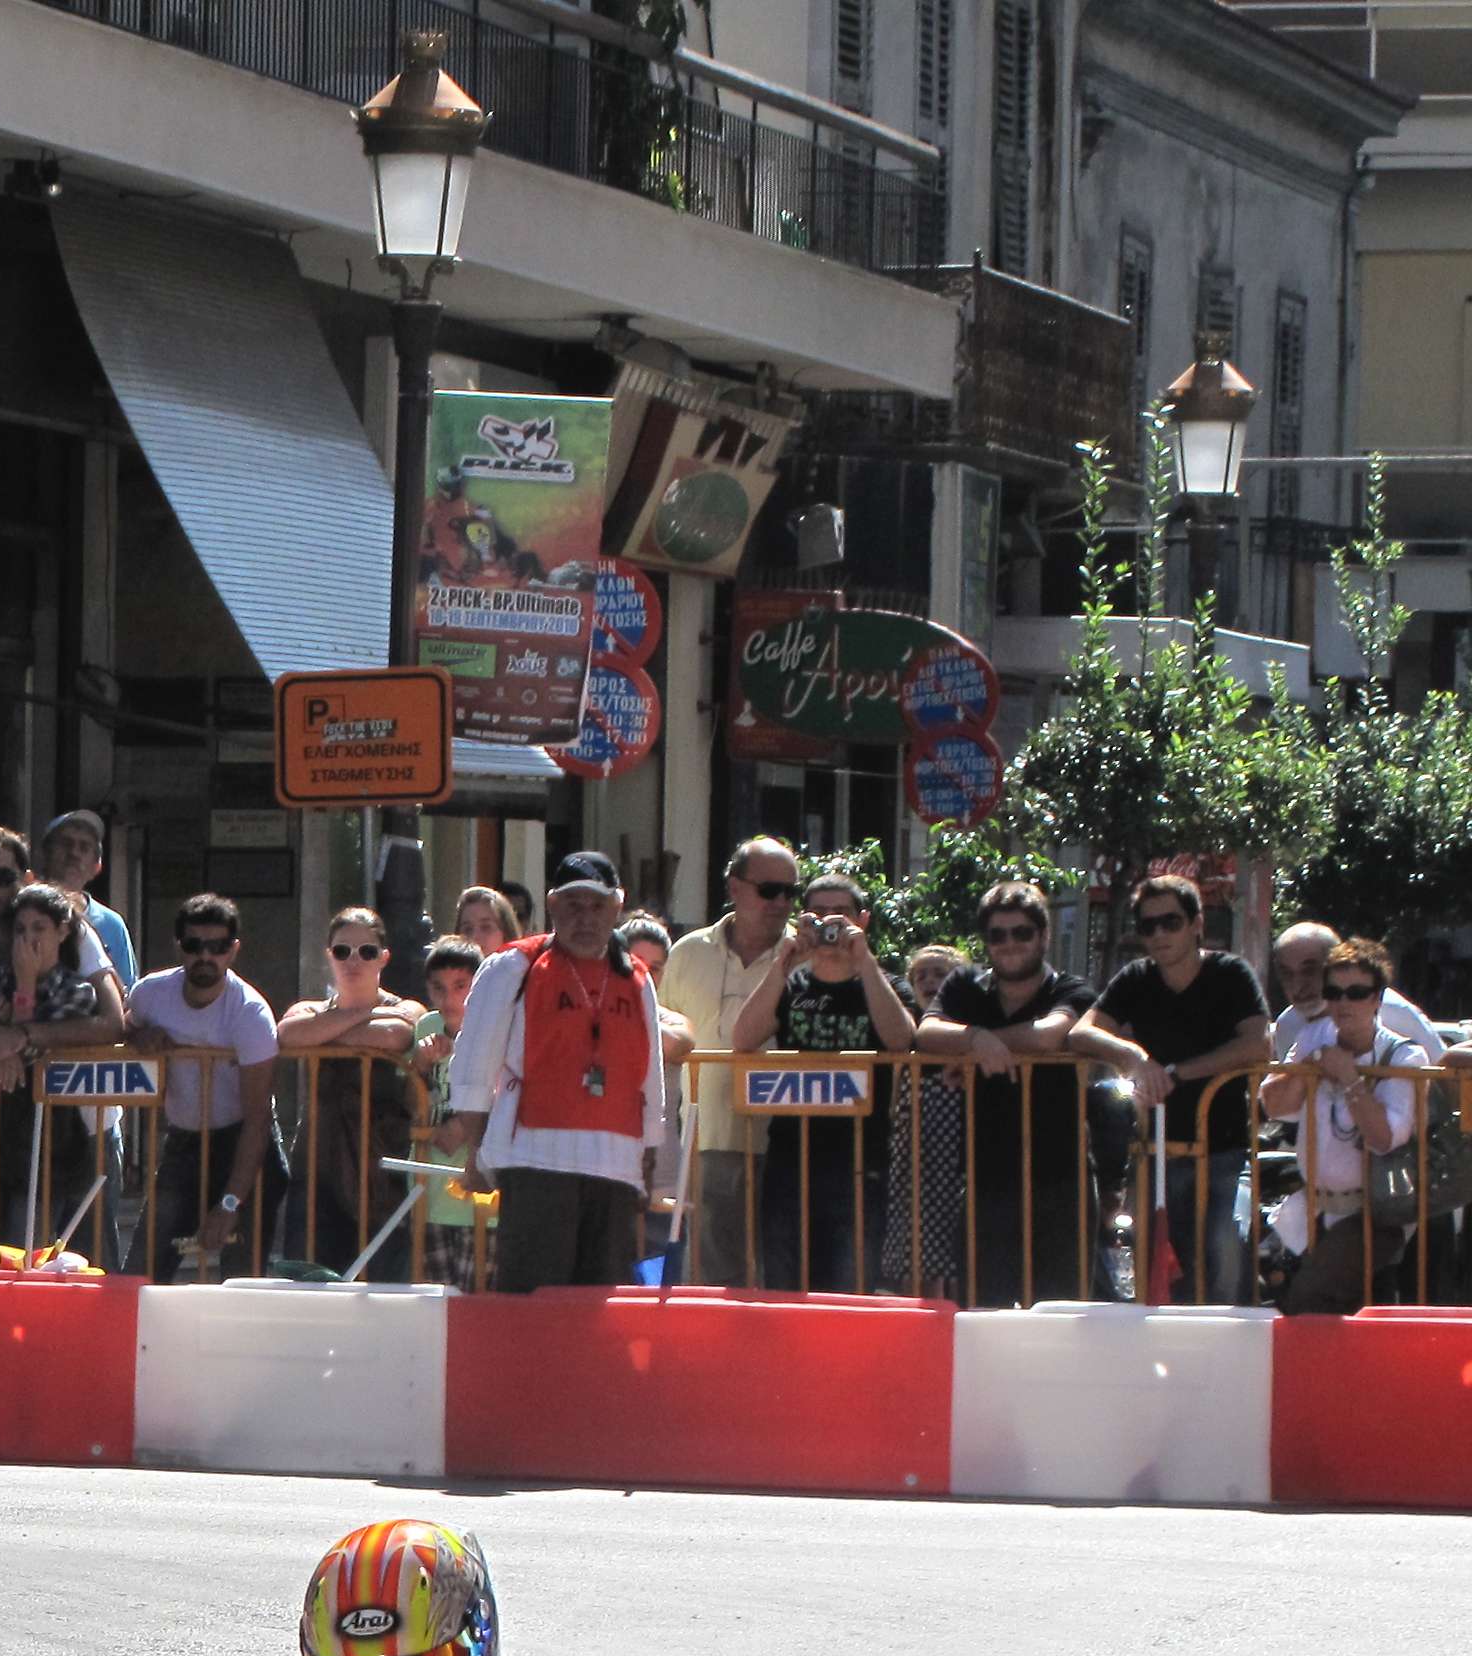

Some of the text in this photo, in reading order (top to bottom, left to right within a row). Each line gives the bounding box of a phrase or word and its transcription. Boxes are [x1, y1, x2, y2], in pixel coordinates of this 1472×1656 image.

[743, 620, 816, 672] Caffe
[308, 699, 329, 726] P
[303, 743, 422, 760] ΕΛΕΓΧΟΜΕΝΗΣ
[310, 766, 415, 783] ΣΤΑΘΜΕΥΣΗΣ
[46, 1062, 155, 1094] ΕΛΠΑ
[748, 1071, 862, 1104] ΕΛΠΑ
[342, 1611, 393, 1630] Arai
